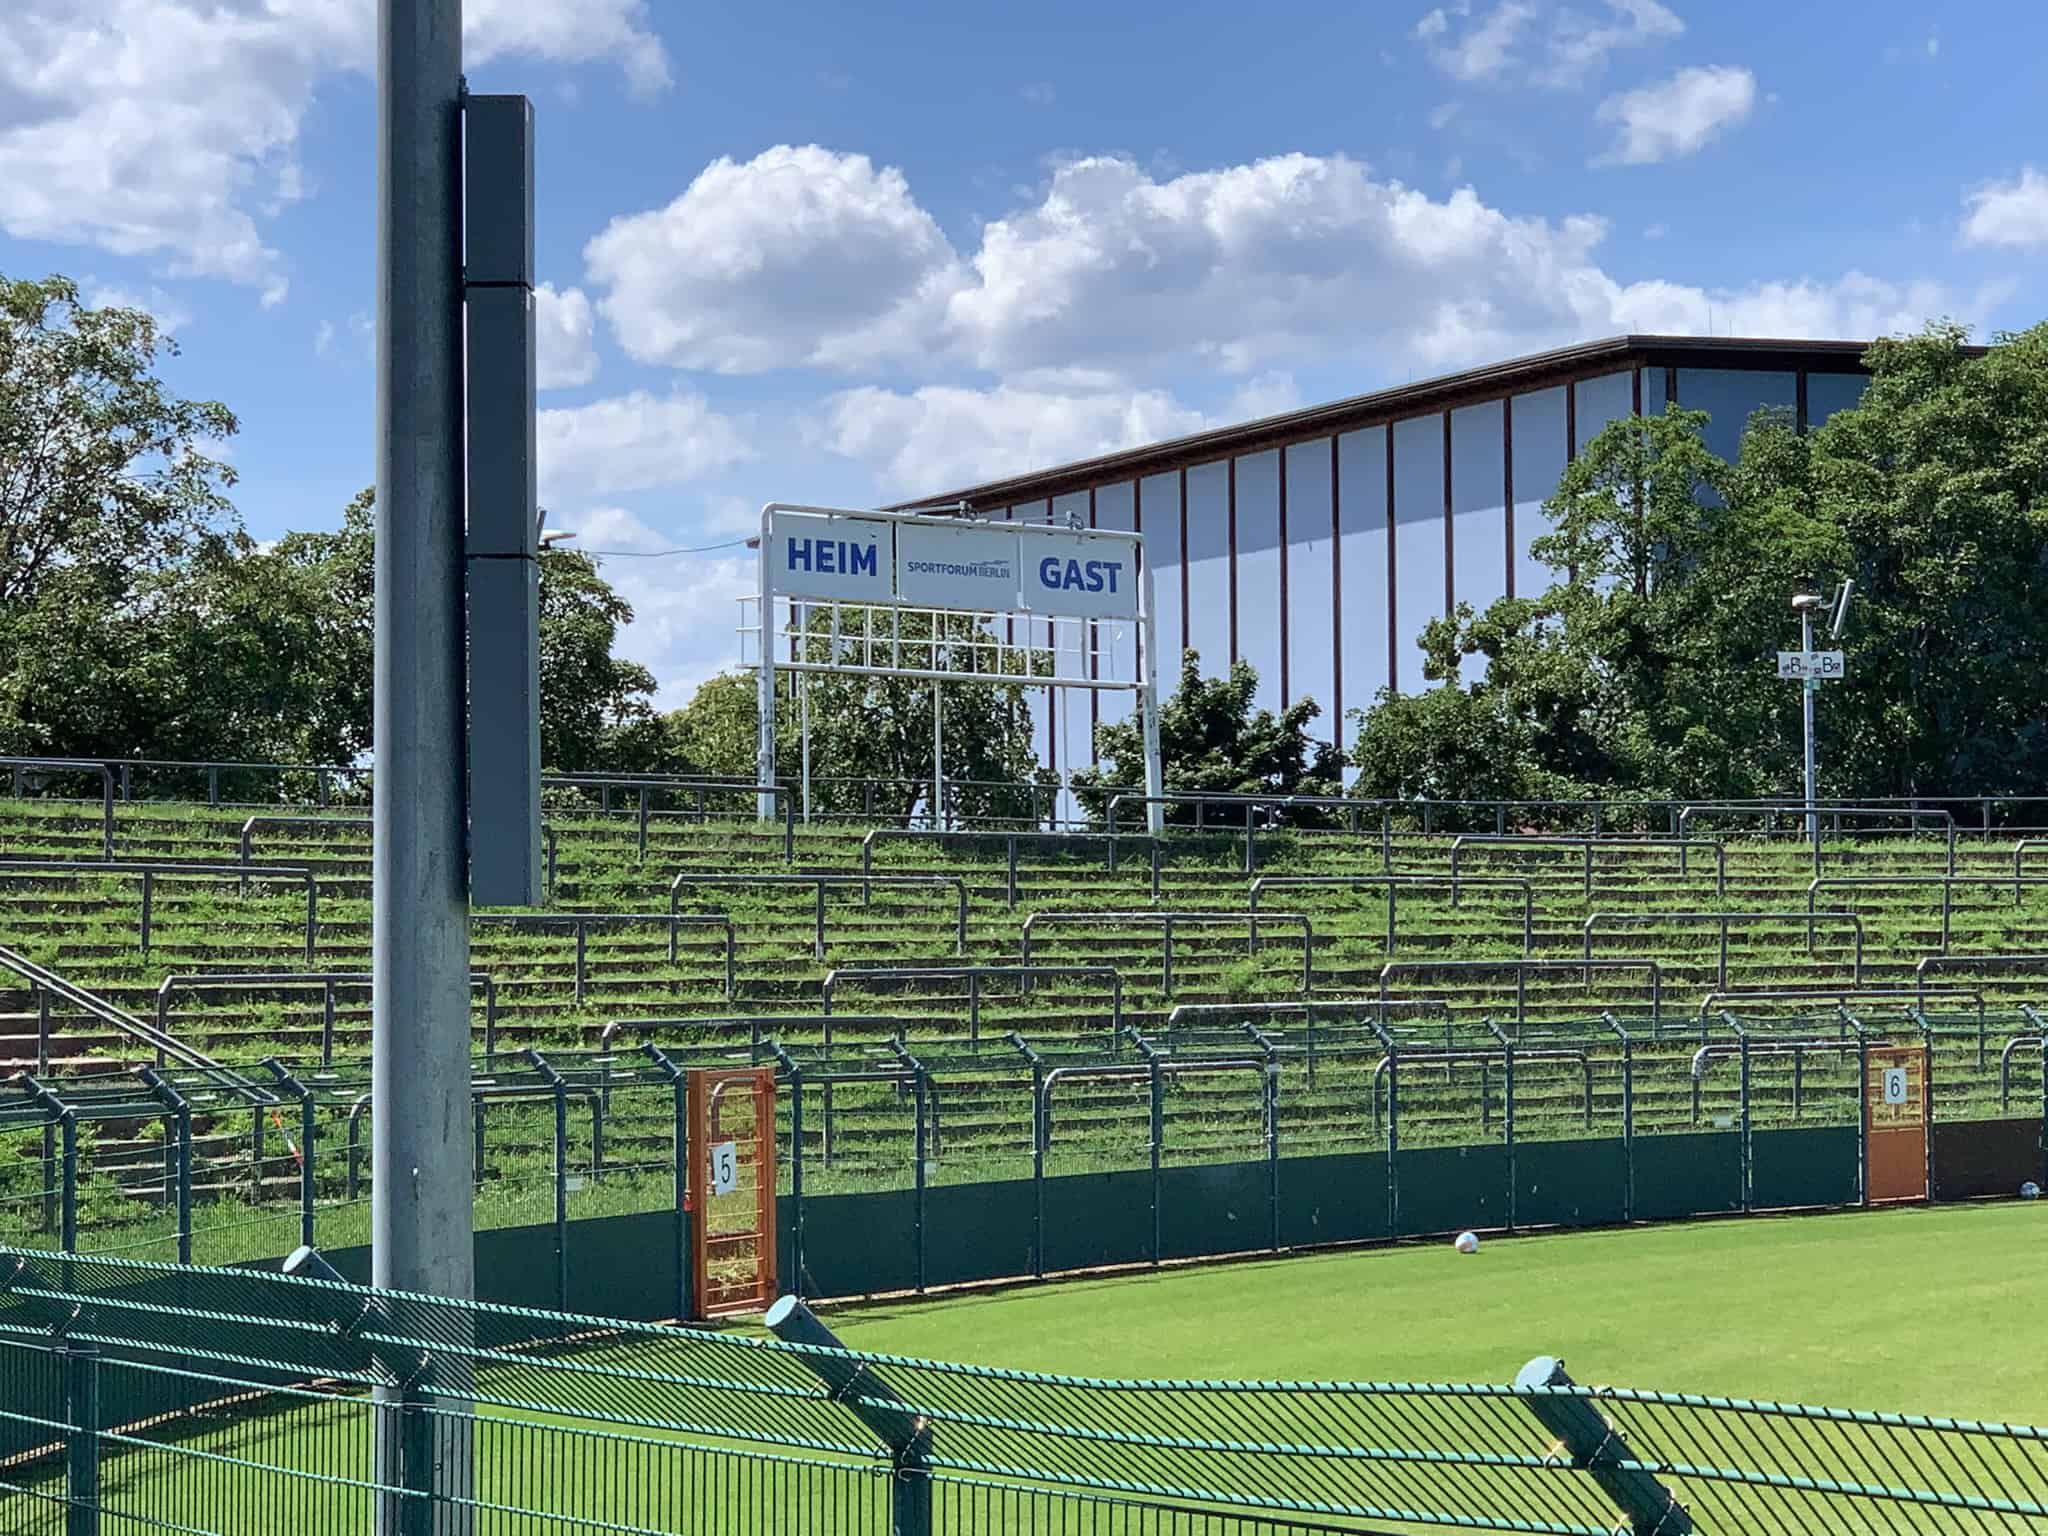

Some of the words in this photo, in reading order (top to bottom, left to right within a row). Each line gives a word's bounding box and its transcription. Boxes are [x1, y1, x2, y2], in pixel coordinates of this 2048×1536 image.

[788, 537, 877, 577] HEIM
[1039, 557, 1122, 593] GAST
[1822, 656, 1833, 673] B
[1890, 1075, 1900, 1098] 6
[721, 1153, 731, 1184] 5
